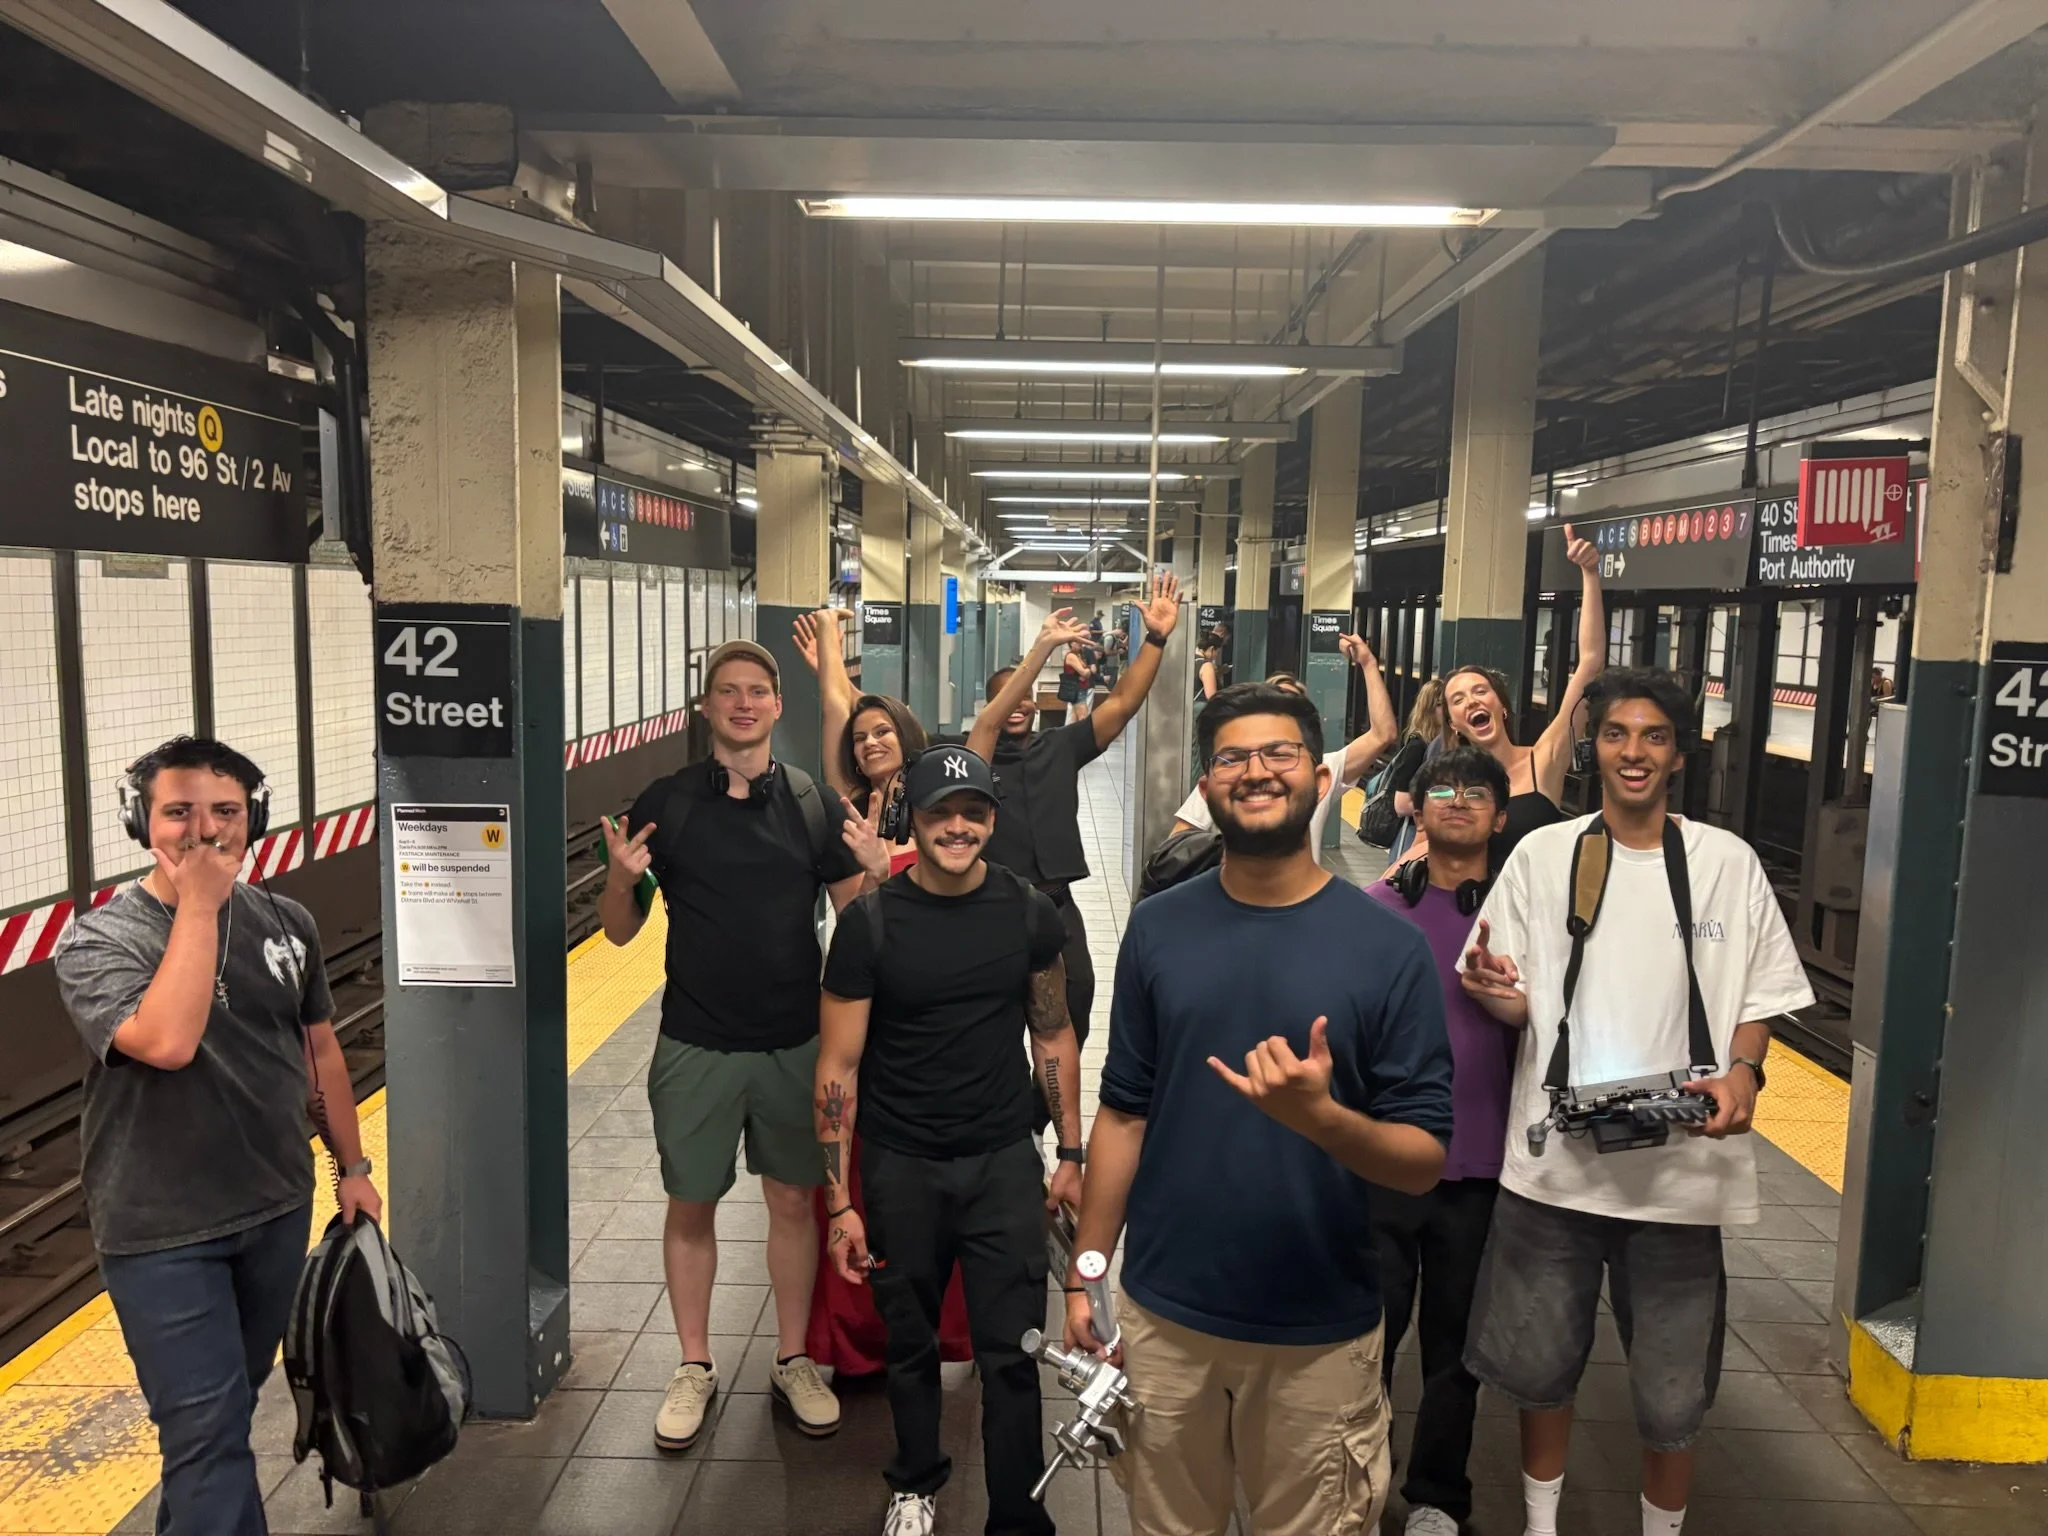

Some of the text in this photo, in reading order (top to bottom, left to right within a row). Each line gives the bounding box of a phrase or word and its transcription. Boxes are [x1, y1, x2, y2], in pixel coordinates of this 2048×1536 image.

[69, 375, 124, 421] Late
[132, 393, 196, 438] nights
[71, 423, 139, 470] Local
[148, 441, 172, 475] to
[179, 444, 209, 481] 96
[272, 463, 292, 493] Av
[74, 477, 201, 523] stops here
[1760, 500, 1799, 527] 40 St
[1760, 530, 1798, 554] Times
[1759, 553, 1856, 583] Port Authority
[864, 607, 890, 616] Times
[864, 615, 893, 624] Square
[1201, 608, 1215, 618] 42
[1312, 615, 1337, 624] Times
[1312, 623, 1341, 632] Square
[384, 626, 460, 677] 42
[386, 691, 504, 728] Street
[943, 755, 969, 779] NY
[398, 822, 500, 843] Weekdays W
[412, 863, 427, 872] will
[428, 864, 439, 872] be
[440, 864, 490, 873] suspended
